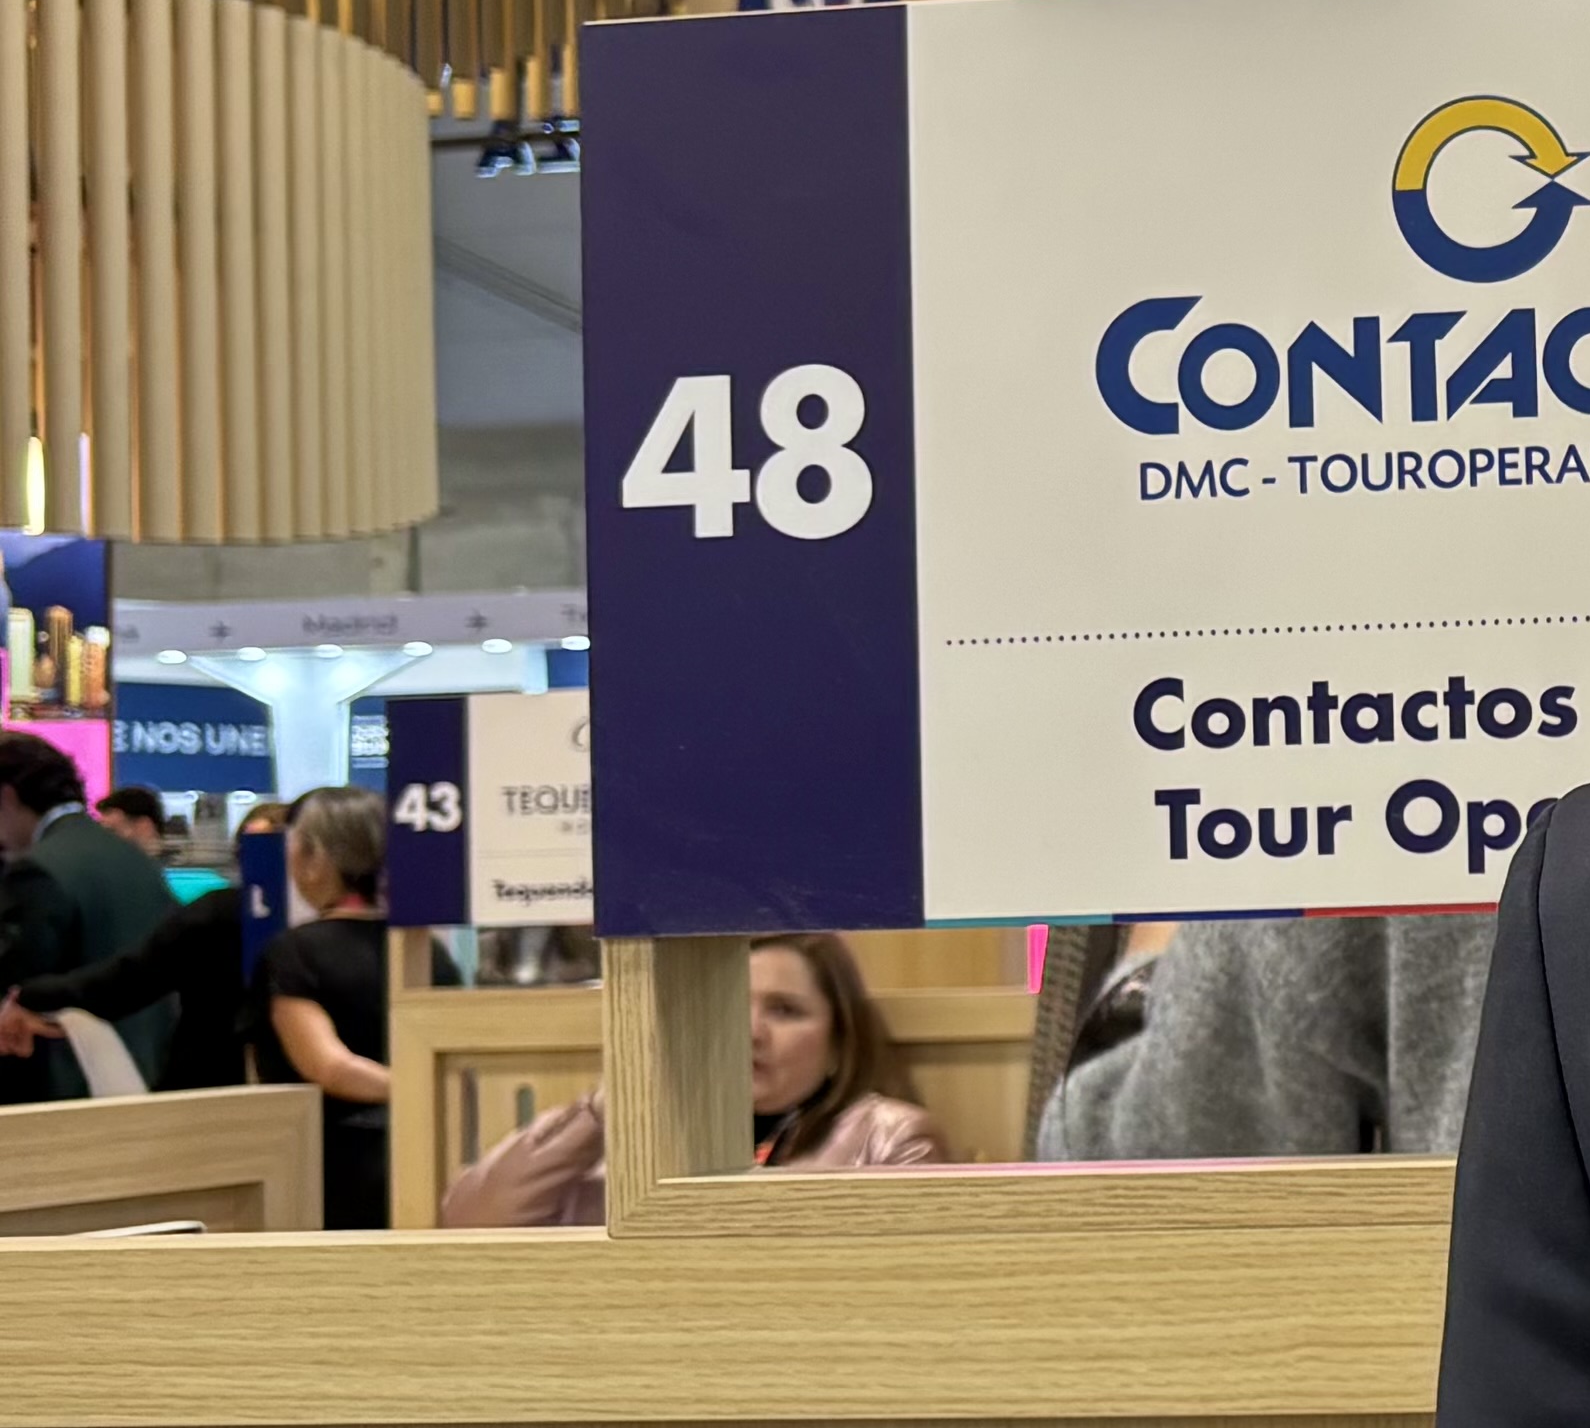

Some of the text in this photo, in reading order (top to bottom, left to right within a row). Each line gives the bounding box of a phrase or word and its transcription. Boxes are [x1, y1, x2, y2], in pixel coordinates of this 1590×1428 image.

[618, 363, 876, 541] 48
[1139, 456, 1251, 502] DMC
[132, 720, 201, 755] NOS
[1131, 673, 1578, 753] Contactos
[394, 781, 463, 832] 43
[1154, 787, 1352, 862] Tour
